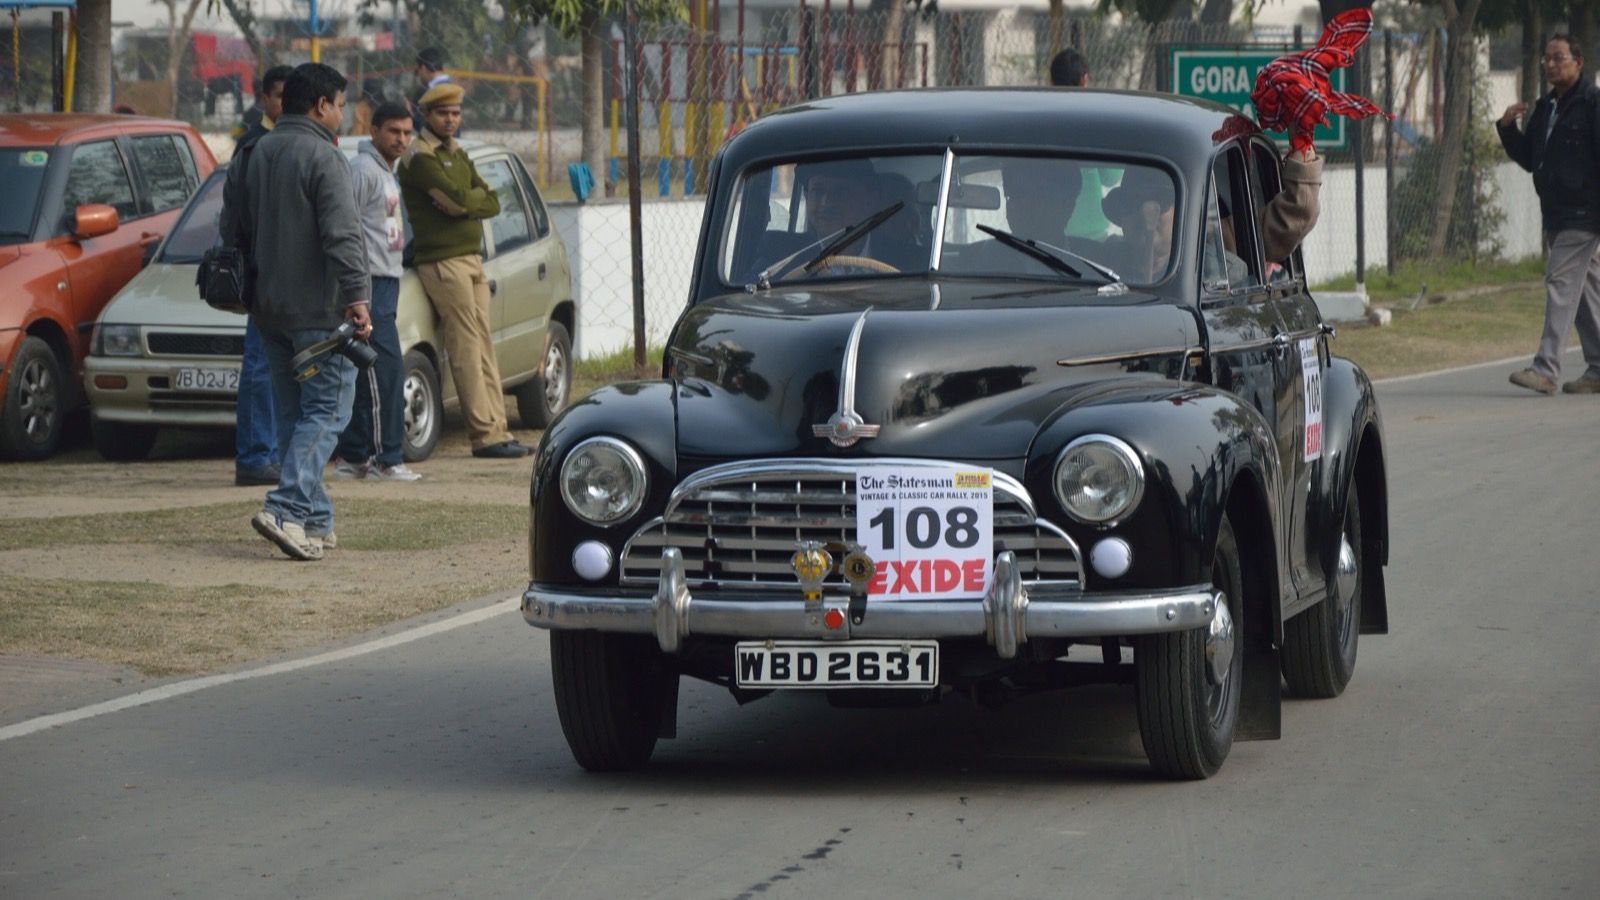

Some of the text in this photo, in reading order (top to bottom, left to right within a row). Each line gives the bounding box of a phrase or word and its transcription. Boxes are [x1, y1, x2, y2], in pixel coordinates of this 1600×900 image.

[1190, 65, 1251, 94] GORA
[859, 475, 885, 490] The
[886, 474, 953, 490] Statesman
[860, 491, 988, 501] VINTAGE & CLASSIC CAR RALLY, 2015
[870, 506, 980, 550] 108
[867, 558, 986, 595] EXIDE
[740, 651, 931, 682] WBD 2631
